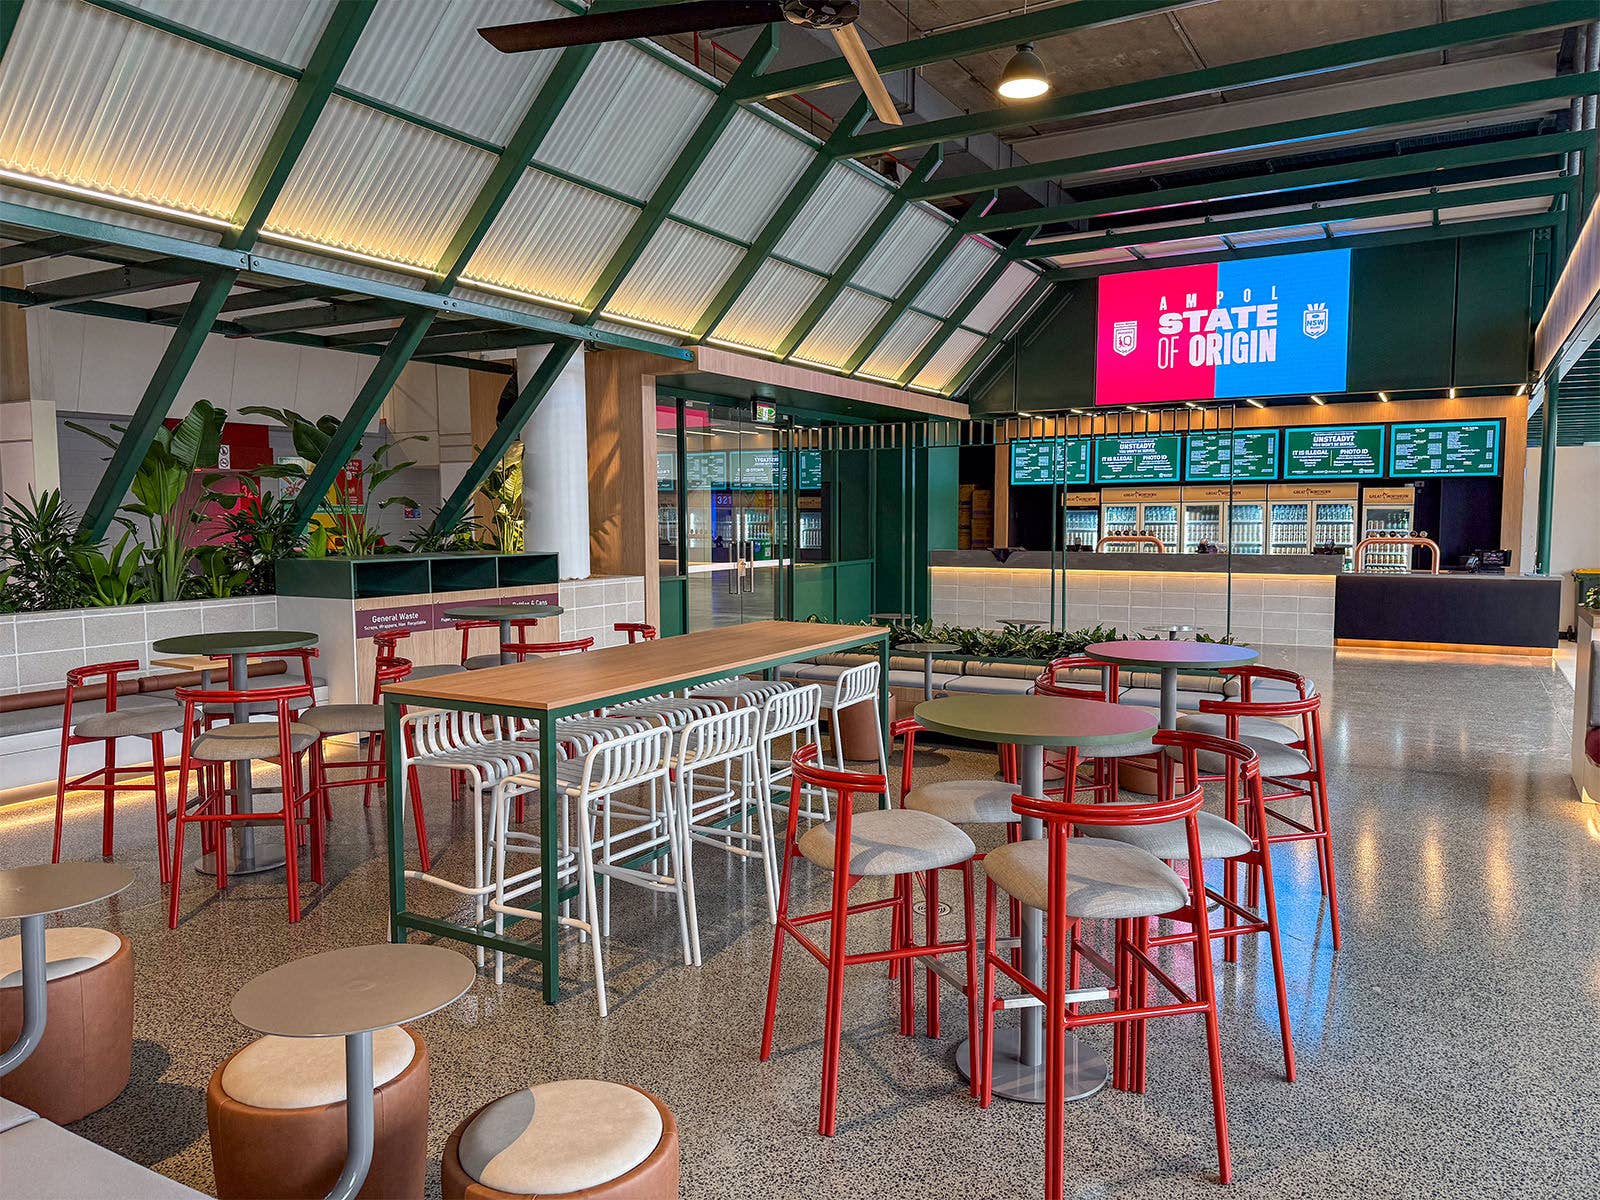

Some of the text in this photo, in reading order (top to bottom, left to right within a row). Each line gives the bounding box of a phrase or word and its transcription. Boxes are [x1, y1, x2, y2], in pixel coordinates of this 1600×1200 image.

[1159, 285, 1278, 311] AMPOL
[1158, 303, 1278, 335] STATE
[1306, 319, 1325, 327] NSW
[1158, 328, 1277, 369] OF ORIGIN
[1313, 435, 1355, 443] UNSTEADY?
[717, 494, 732, 505] 321
[371, 612, 419, 623] General Waste
